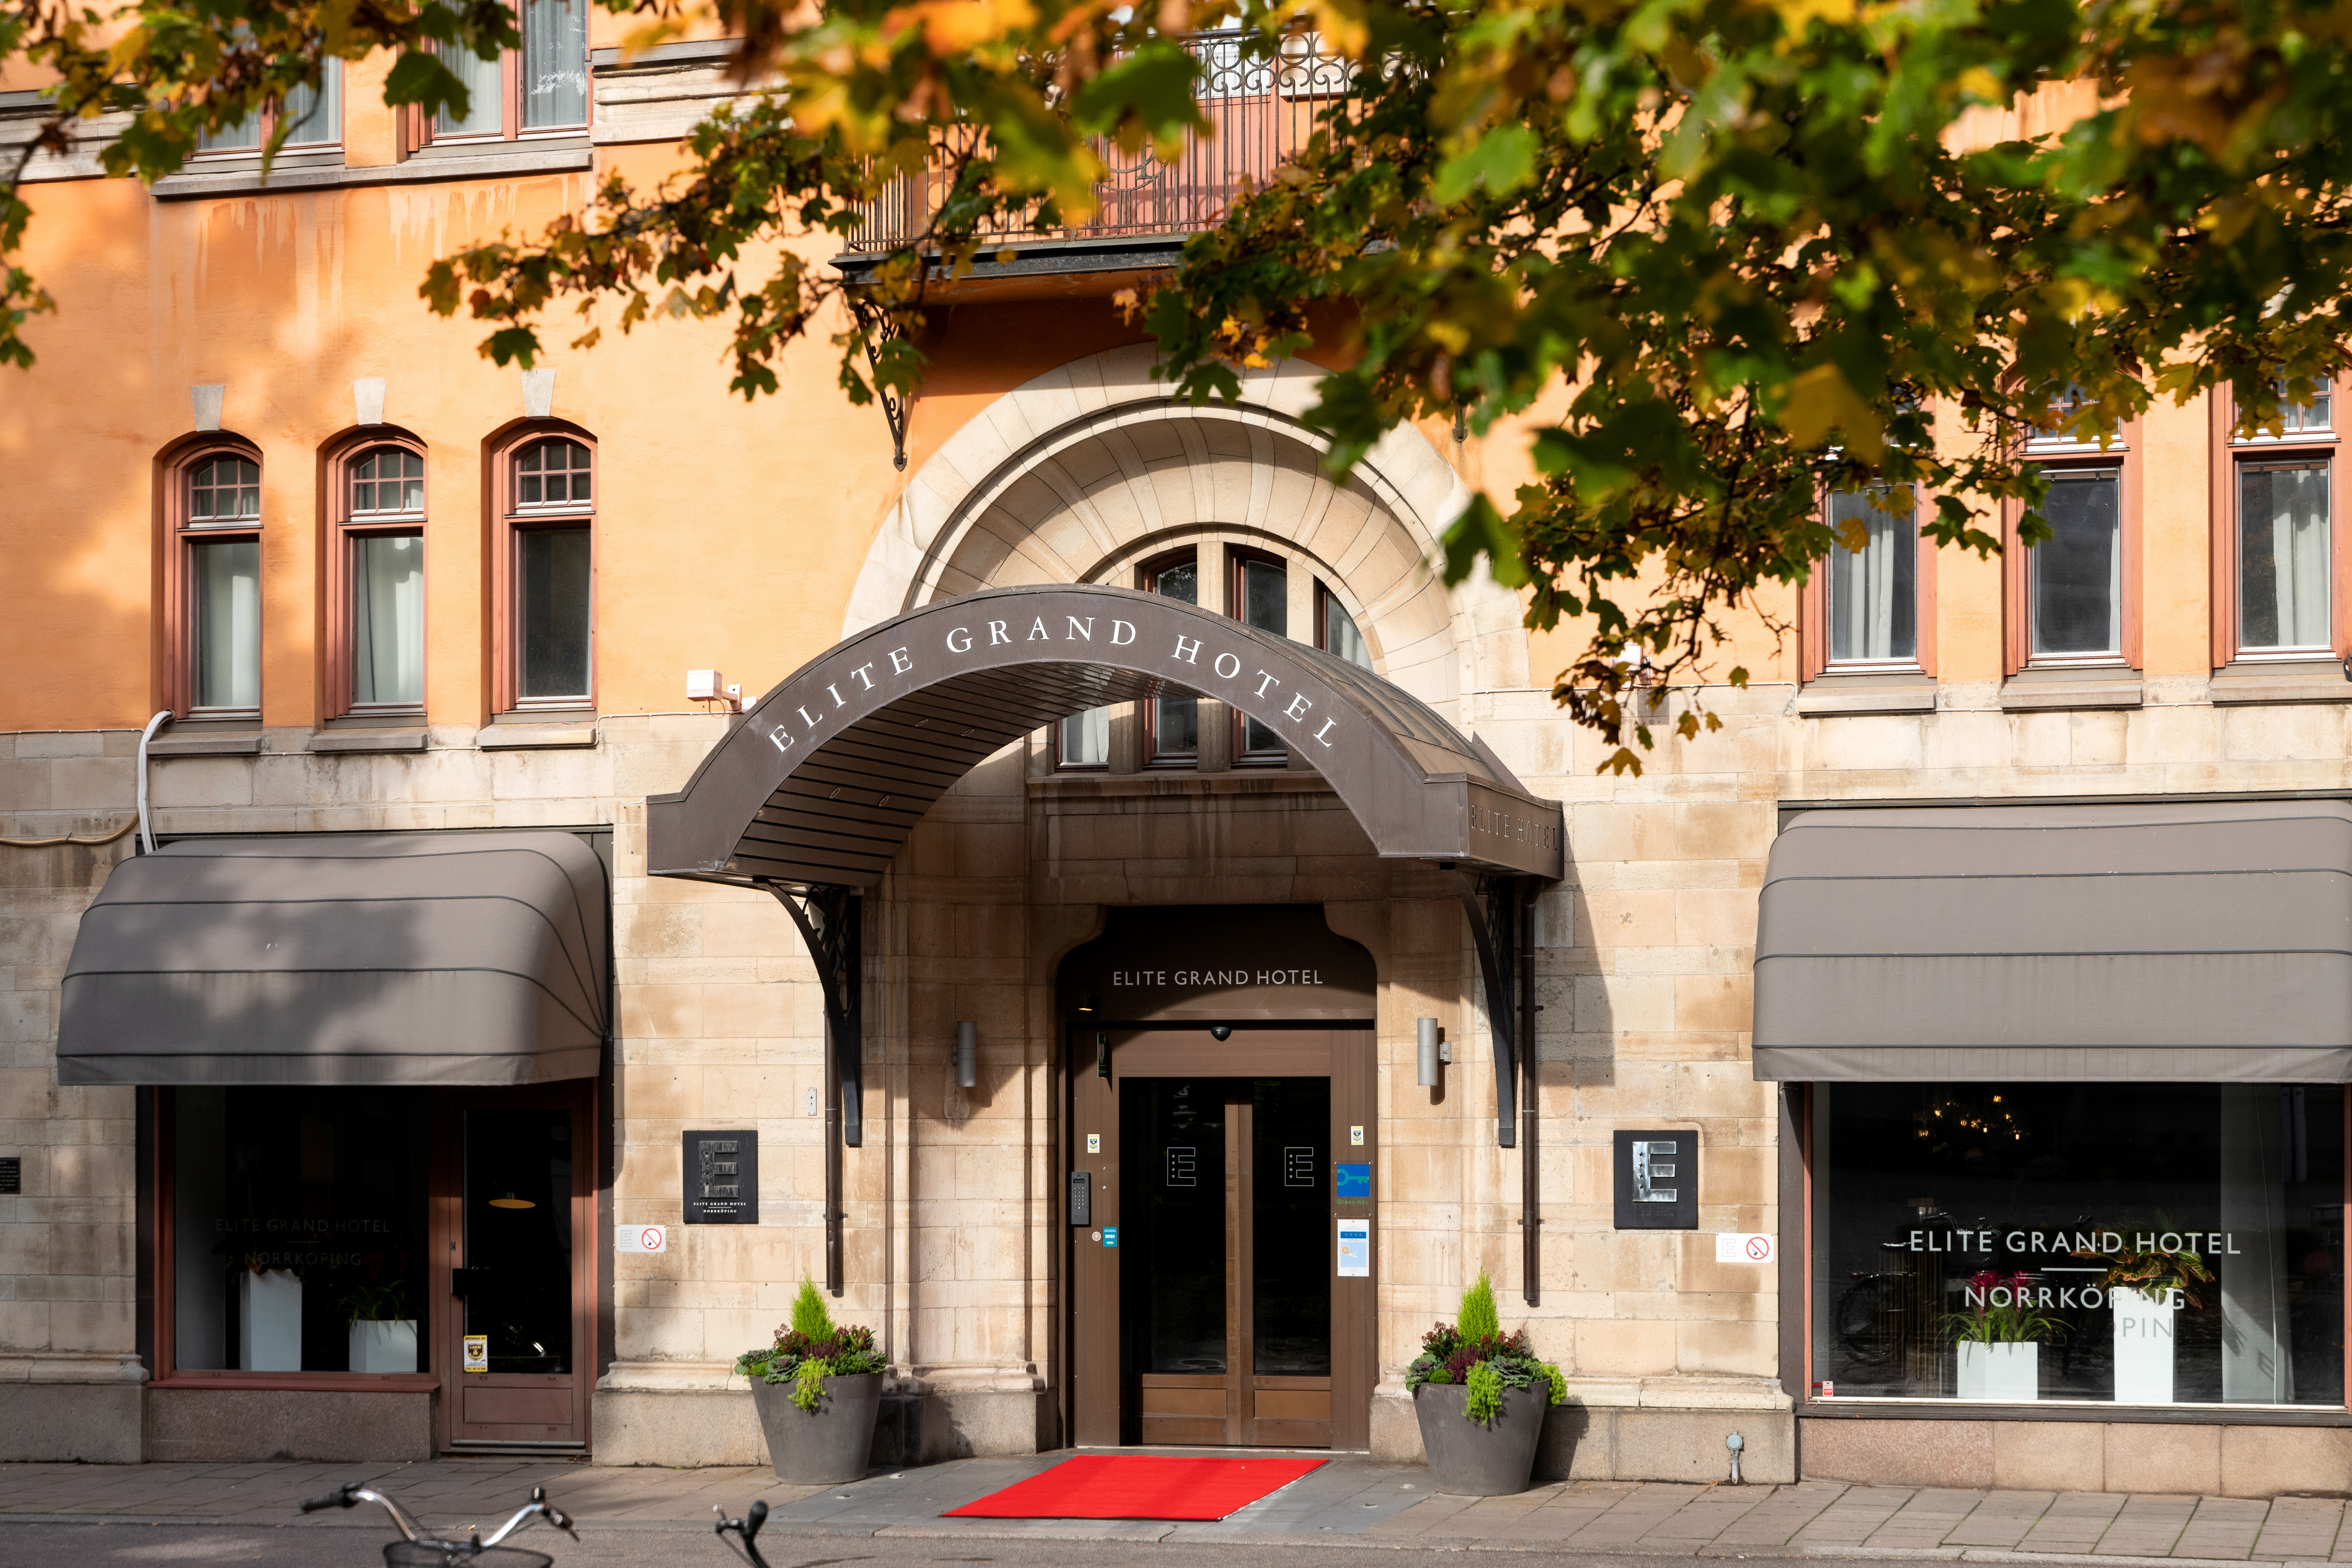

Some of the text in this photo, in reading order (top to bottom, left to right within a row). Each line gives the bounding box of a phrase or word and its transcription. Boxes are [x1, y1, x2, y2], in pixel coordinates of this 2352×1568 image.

[769, 616, 1336, 753] ELITE GRAND HOTEL
[1471, 804, 1558, 851] ELITE HOTEL
[1114, 969, 1323, 985] ELITE GRAND HOTEL
[216, 1219, 390, 1232] ELITE GRAND HOTEL
[1910, 1230, 2241, 1254] ELITE GRAND HOTEL
[244, 1250, 361, 1266] NORRKÖPING
[1965, 1283, 2185, 1310] NORRKÖPING
